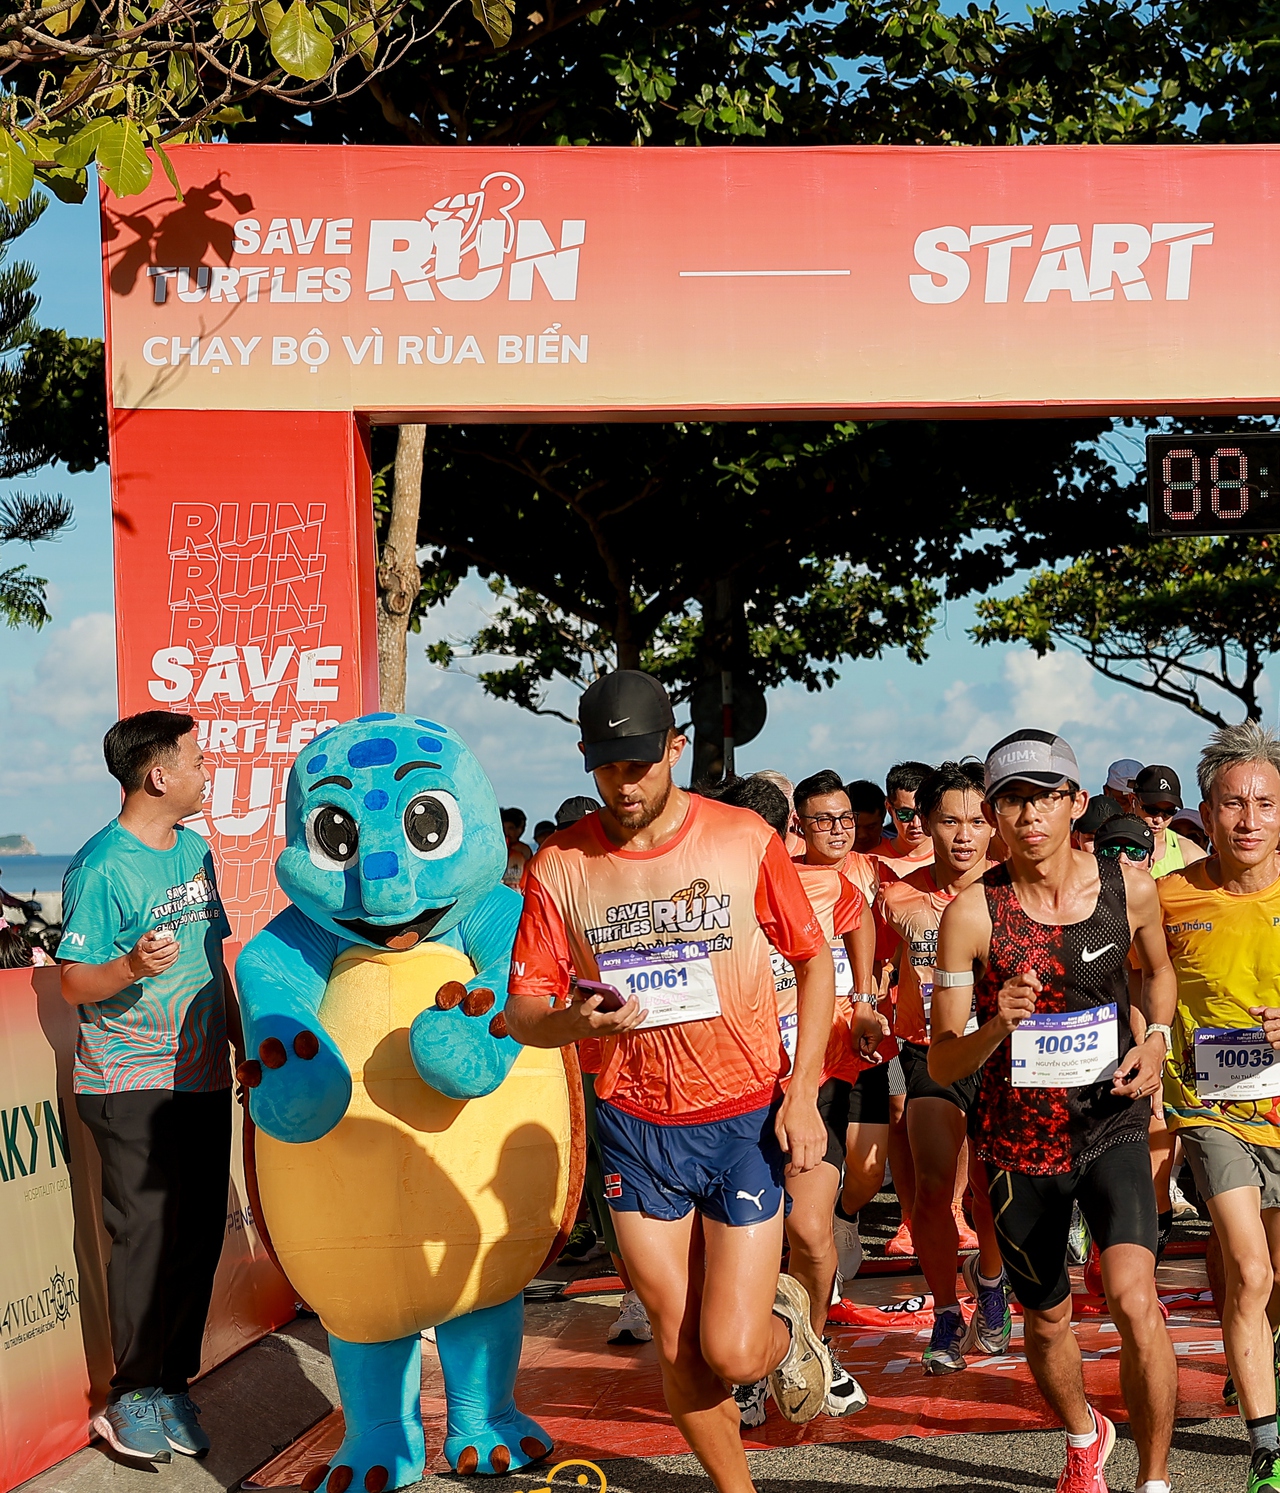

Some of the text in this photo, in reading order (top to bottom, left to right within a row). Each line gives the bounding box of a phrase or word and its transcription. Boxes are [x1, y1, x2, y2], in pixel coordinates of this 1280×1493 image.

[232, 218, 353, 255] SAVE
[365, 219, 586, 301] RUN
[909, 223, 1215, 305] START
[147, 266, 352, 304] TURTLES
[142, 322, 589, 373] CHẠY BỘ VÌ RÙA BIỂN
[168, 502, 327, 561] RUN
[168, 554, 327, 612] RUN
[148, 646, 343, 702] SAVE
[606, 901, 650, 923] SAVE
[652, 894, 731, 933] RUN
[1182, 919, 1213, 932] Thắng
[585, 919, 651, 945] TURTLES
[682, 945, 699, 959] 10
[626, 967, 688, 994] 10061
[1096, 1006, 1110, 1021] 10
[1035, 1031, 1099, 1054] 10032
[1215, 1048, 1274, 1068] 10035
